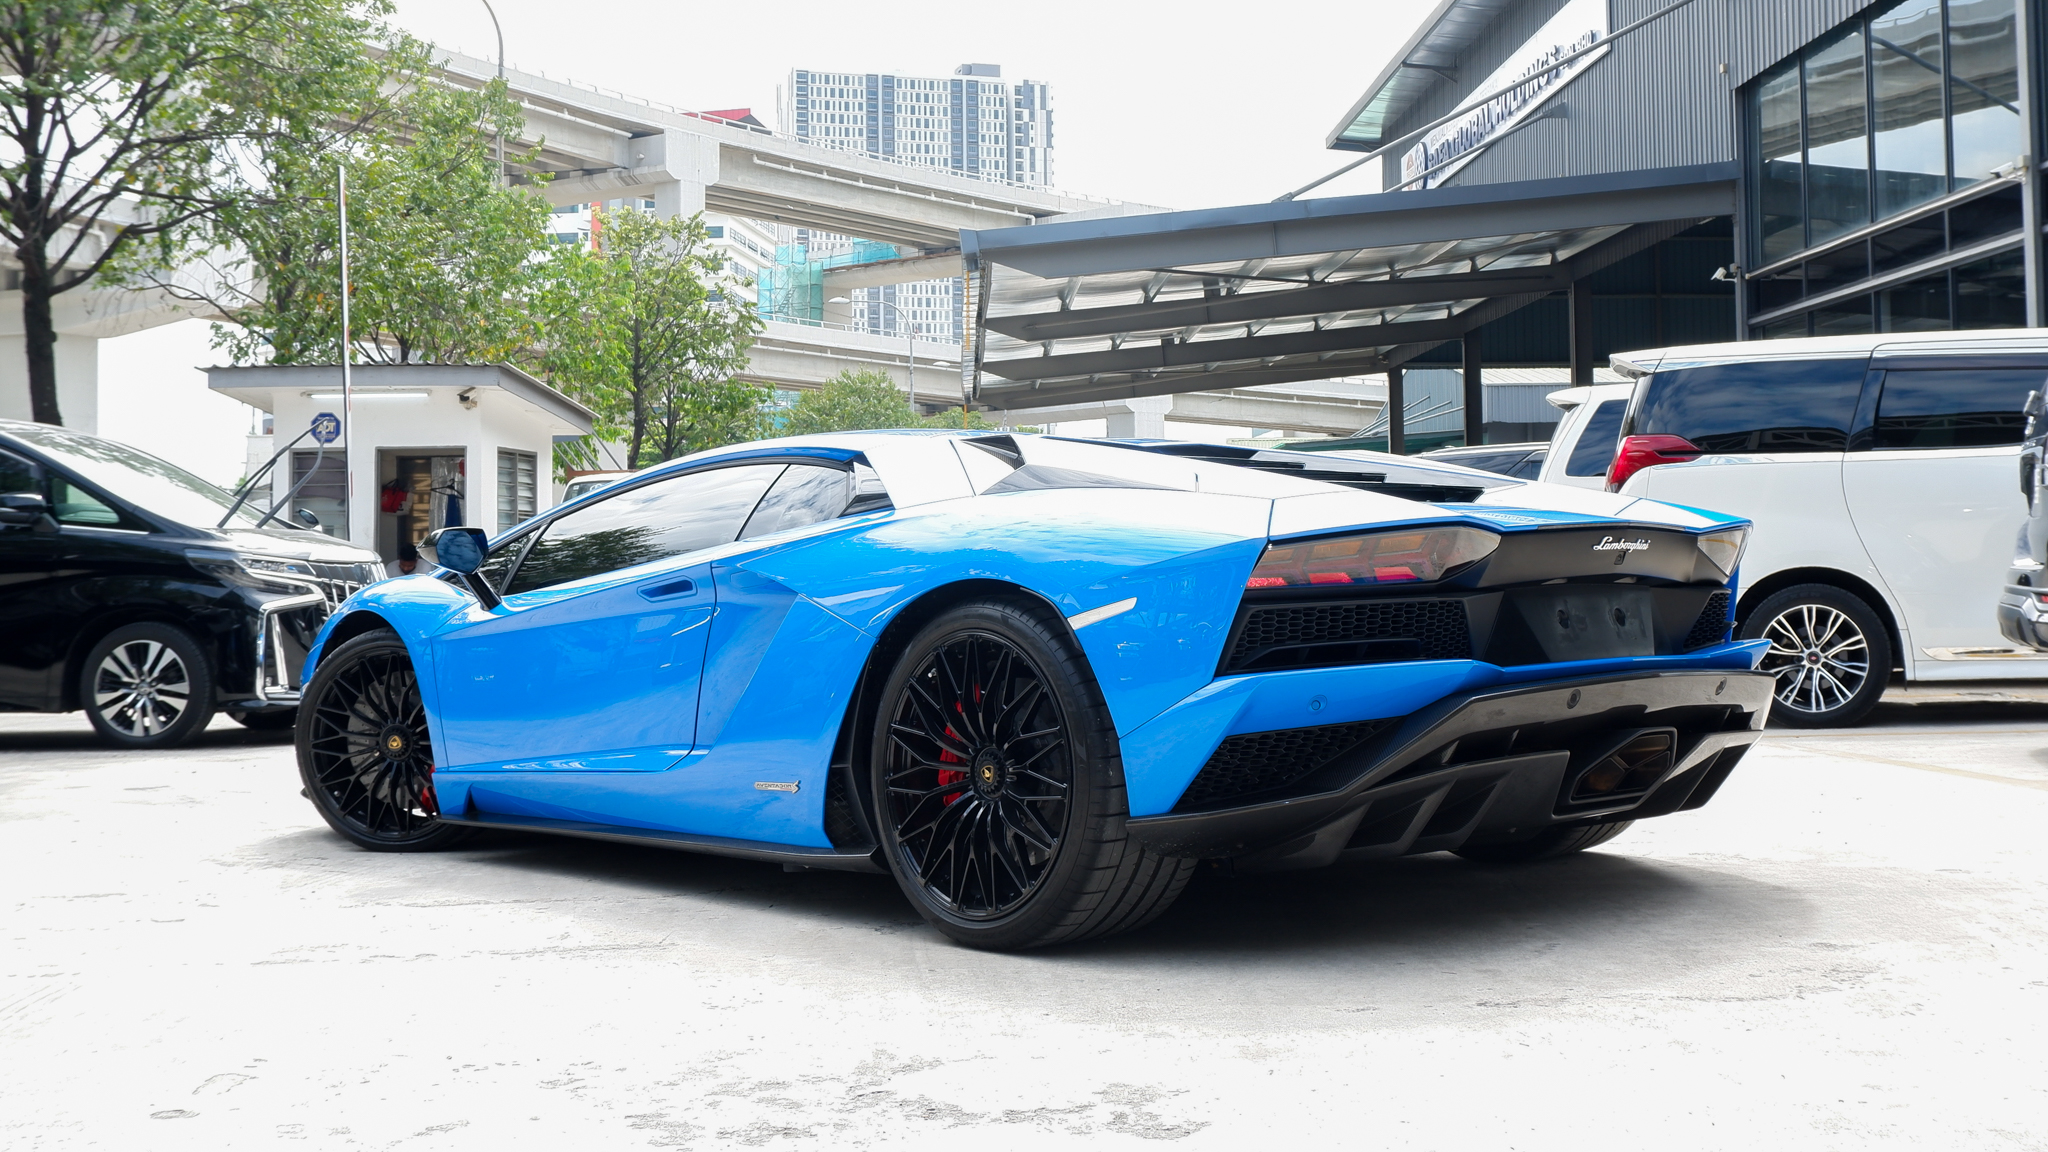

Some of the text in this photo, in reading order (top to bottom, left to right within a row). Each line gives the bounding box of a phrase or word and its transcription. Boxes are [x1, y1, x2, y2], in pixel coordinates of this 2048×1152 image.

[1451, 102, 1494, 158] GLOBAL
[1495, 45, 1560, 126] HOLDINGS
[316, 422, 336, 433] ADT
[1593, 536, 1651, 553] Lamborghini
